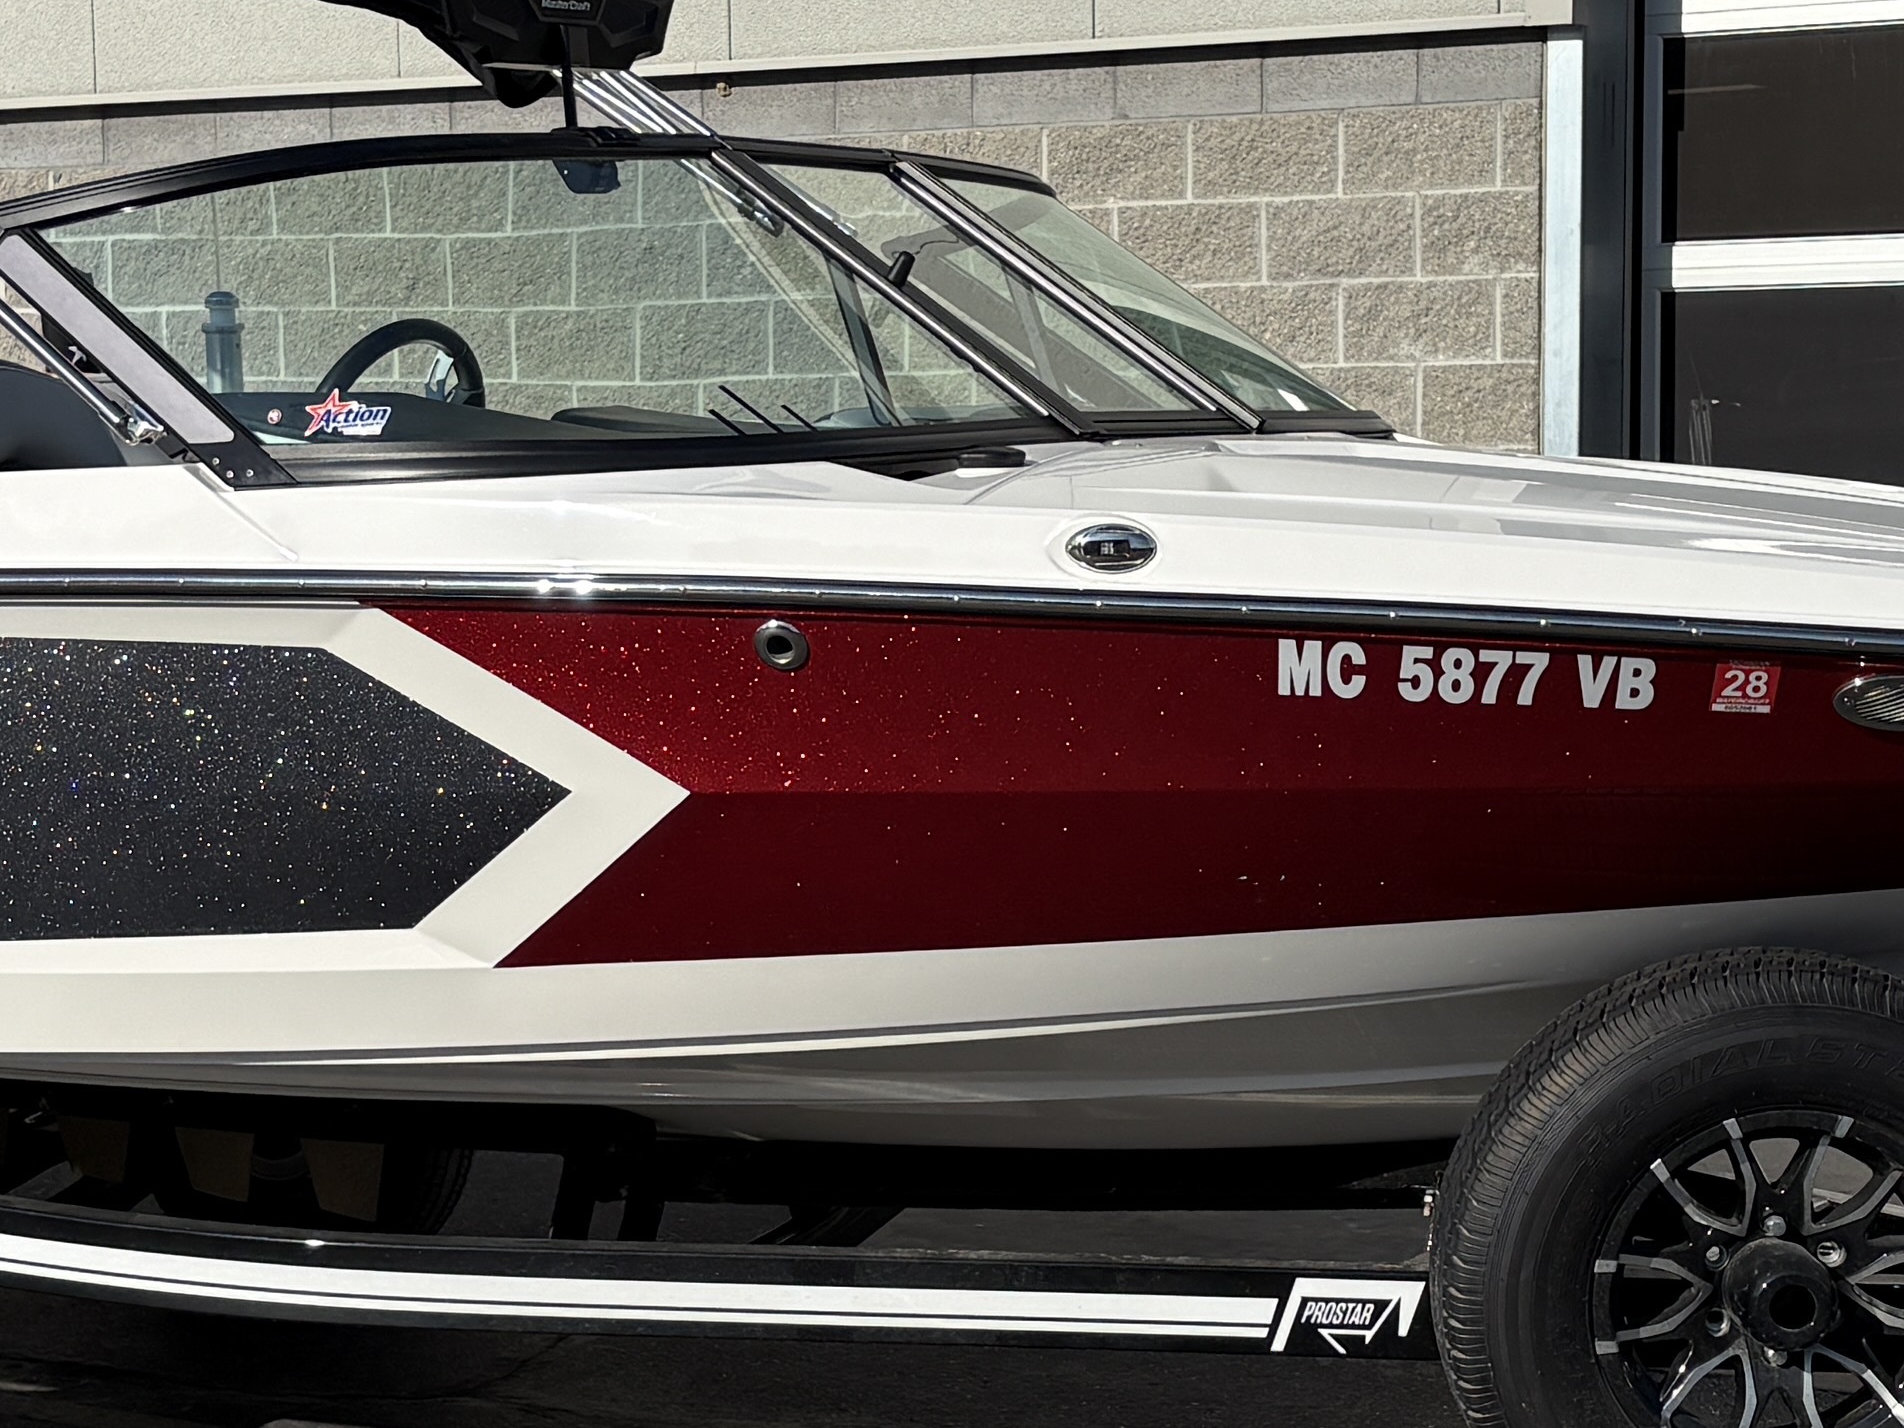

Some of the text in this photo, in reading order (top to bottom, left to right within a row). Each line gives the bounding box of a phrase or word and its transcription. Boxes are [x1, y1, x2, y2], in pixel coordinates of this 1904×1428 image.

[319, 408, 389, 429] Action
[1277, 640, 1657, 711] MC 5877 VB
[1721, 670, 1769, 698] 28
[1301, 1301, 1375, 1325] PROSTAR
